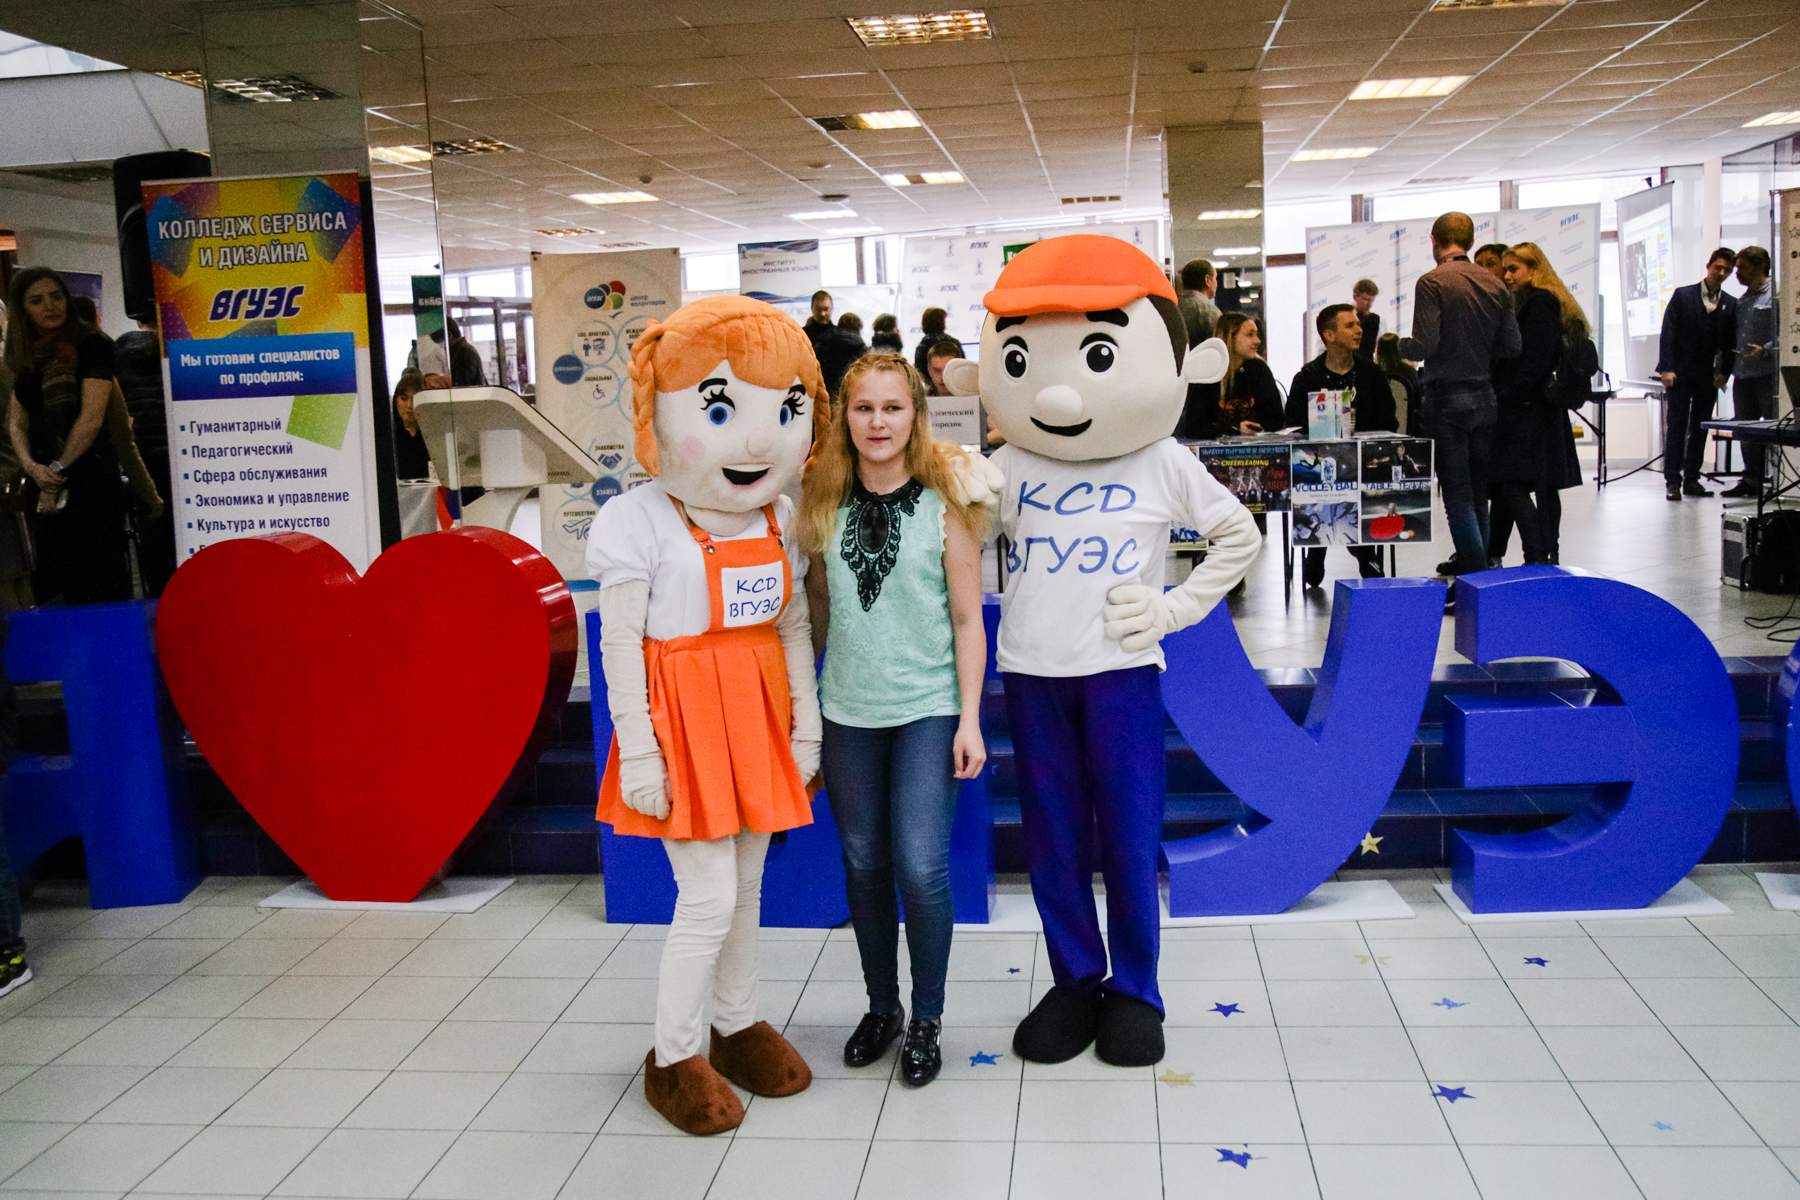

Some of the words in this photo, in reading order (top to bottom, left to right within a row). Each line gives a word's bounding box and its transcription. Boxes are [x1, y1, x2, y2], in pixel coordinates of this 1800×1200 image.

[158, 216, 255, 240] КОЛЛЕДЖ
[260, 211, 348, 235] СЕРВИСА
[199, 247, 213, 268] И
[217, 240, 309, 270] ДИЗАЙНА
[208, 286, 305, 321] ВГУЭС
[181, 354, 201, 367] Мы
[206, 353, 256, 366] готовим
[259, 349, 341, 365] специалистов
[220, 374, 236, 385] по
[239, 371, 304, 386] профилям:
[189, 417, 282, 436] Гуманитарный
[192, 442, 293, 460] Педагогический
[193, 469, 235, 484] Сфера
[239, 466, 328, 483] обслуживания
[195, 491, 264, 507] Экономика
[268, 494, 275, 504] и
[278, 490, 350, 506] управление
[1018, 480, 1137, 516] KCD
[197, 518, 255, 533] Культура
[258, 518, 266, 529] и
[270, 515, 330, 530] искусство
[1007, 535, 1140, 576] ВГУЭС
[736, 577, 777, 594] KCD
[729, 596, 780, 618] ВГУЭС
